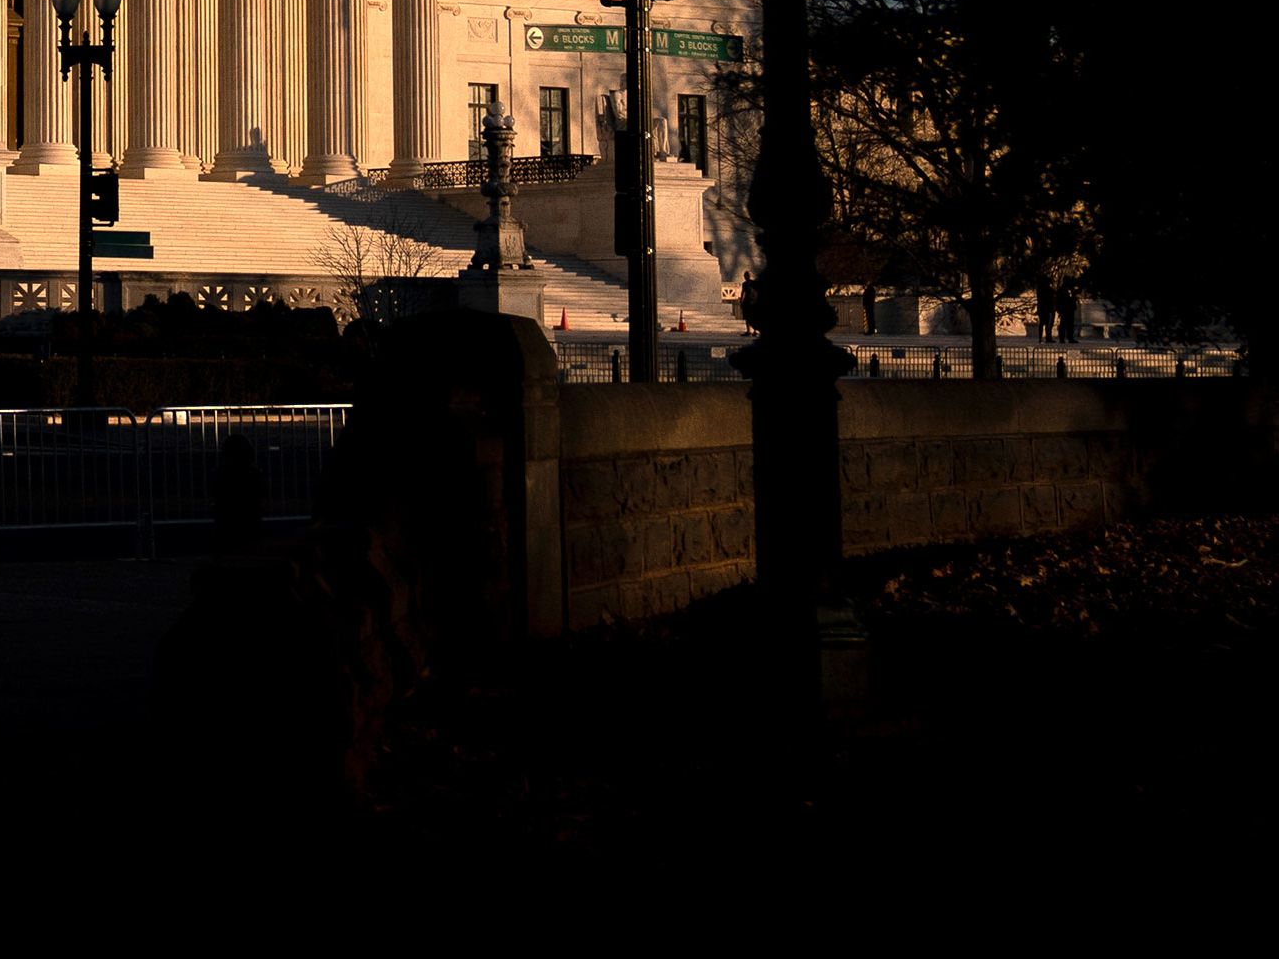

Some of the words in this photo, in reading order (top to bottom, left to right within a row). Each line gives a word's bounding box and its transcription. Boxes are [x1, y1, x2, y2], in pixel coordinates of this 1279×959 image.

[553, 35, 559, 43] 6
[562, 35, 595, 44] BLOCKS
[606, 30, 619, 45] M
[656, 32, 668, 48] M
[680, 40, 685, 49] 3
[688, 41, 718, 52] BLOCKS
